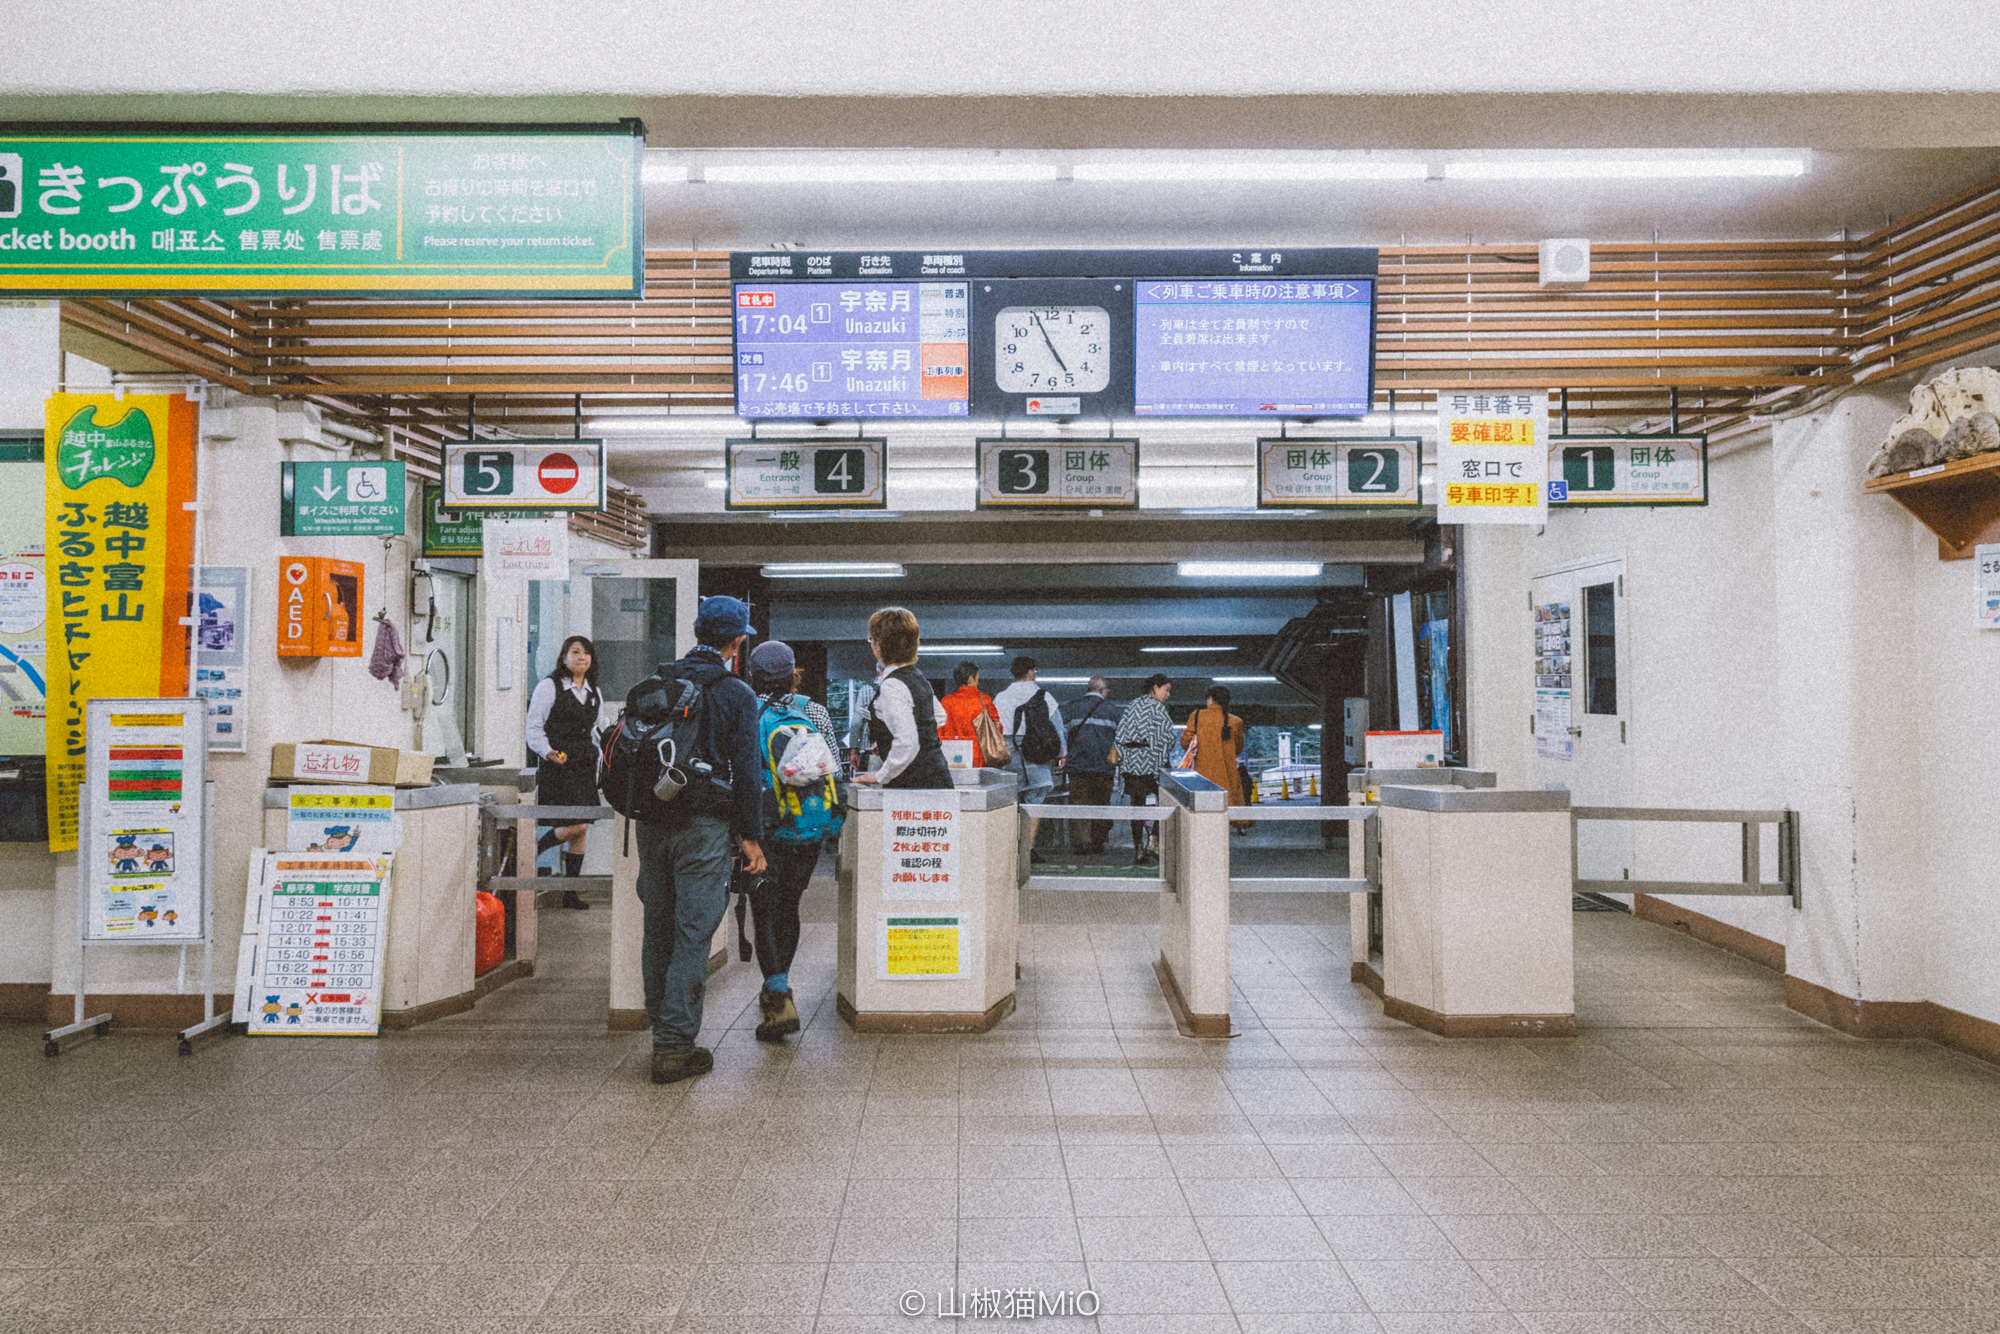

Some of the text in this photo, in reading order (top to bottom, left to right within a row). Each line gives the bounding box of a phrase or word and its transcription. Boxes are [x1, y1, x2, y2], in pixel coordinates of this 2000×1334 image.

[472, 152, 548, 170] お客様へ
[38, 162, 383, 216] きっぷうりば
[424, 205, 562, 224] 予約してください
[59, 227, 136, 250] booth
[151, 228, 226, 251] 매표소
[238, 229, 305, 251] 售票处
[316, 229, 383, 251] 售票處
[423, 235, 596, 248] Please reserve your return ticket.
[750, 256, 791, 267] 発車時刻
[807, 256, 832, 266] のりば
[860, 255, 891, 266] 行き先
[1232, 253, 1281, 264] ご案内
[748, 267, 793, 276] Departure time
[807, 267, 832, 275] Platform
[858, 266, 893, 275] Destination
[920, 266, 965, 275] Class of coach
[1239, 264, 1274, 272] Information
[944, 289, 965, 299] 普通
[739, 294, 773, 306] 改札中
[840, 290, 910, 313] 宇奈月
[944, 308, 965, 319] 特別
[1045, 310, 1060, 320] 12
[1067, 314, 1073, 324] 1
[737, 314, 808, 334] 17:04
[845, 317, 906, 334] Unazuki
[1014, 327, 1028, 338] 10
[1080, 325, 1090, 335] 2
[1007, 343, 1017, 354] 9
[1088, 343, 1098, 354] 3
[741, 354, 763, 365] 次発
[841, 349, 911, 372] 宇奈月
[925, 366, 964, 376] 工事列車
[1014, 361, 1024, 372] 8
[1080, 361, 1089, 372] 4
[739, 373, 809, 393] 17:46
[846, 376, 906, 392] Unazuki
[1031, 373, 1040, 384] 7
[1047, 376, 1057, 387] 6
[1064, 373, 1074, 384] 5
[1451, 395, 1534, 415] 号車番号
[1451, 422, 1527, 442] 要確認！
[755, 450, 800, 471] 一般
[1065, 450, 1110, 471] 団体
[1286, 449, 1332, 470] 団体
[1630, 446, 1676, 467] 団体
[476, 453, 501, 493] 5
[827, 452, 853, 490] 4
[1013, 453, 1037, 491] 3
[1361, 451, 1387, 490] 2
[1462, 459, 1523, 478] 窓口で
[1580, 450, 1595, 488] 1
[760, 473, 800, 482] Entrance
[1065, 473, 1095, 483] Group
[1303, 473, 1332, 483] Group
[1630, 470, 1660, 480] Group
[1447, 486, 1532, 503] 号車印字！
[299, 505, 399, 516] 車イスご利用ください
[500, 537, 551, 552] 忘れ物
[101, 501, 150, 622] 越中富山
[502, 560, 550, 569] Lost thing
[287, 586, 305, 639] AED
[56, 502, 97, 756] ふるさとチャレンジ
[303, 752, 360, 772] 忘れ物
[891, 810, 953, 821] 列車に乗車の
[896, 826, 947, 837] 際は切符が
[892, 842, 950, 853] 2枚必要です
[901, 857, 942, 869] 確認の程
[892, 872, 950, 883] お願いします
[288, 897, 370, 907] 8:53 10:17
[282, 910, 367, 920] 10:22 11:41
[280, 923, 367, 933] 12:07 13:25
[279, 937, 366, 947] 14:16 15:33
[278, 950, 365, 960] 15:40 16:56
[276, 963, 364, 973] 16:22 17:37
[275, 977, 363, 987] 17:46 19:00
[307, 1006, 362, 1014] 一般のお客様は
[307, 1016, 369, 1024] ご乗車できません
